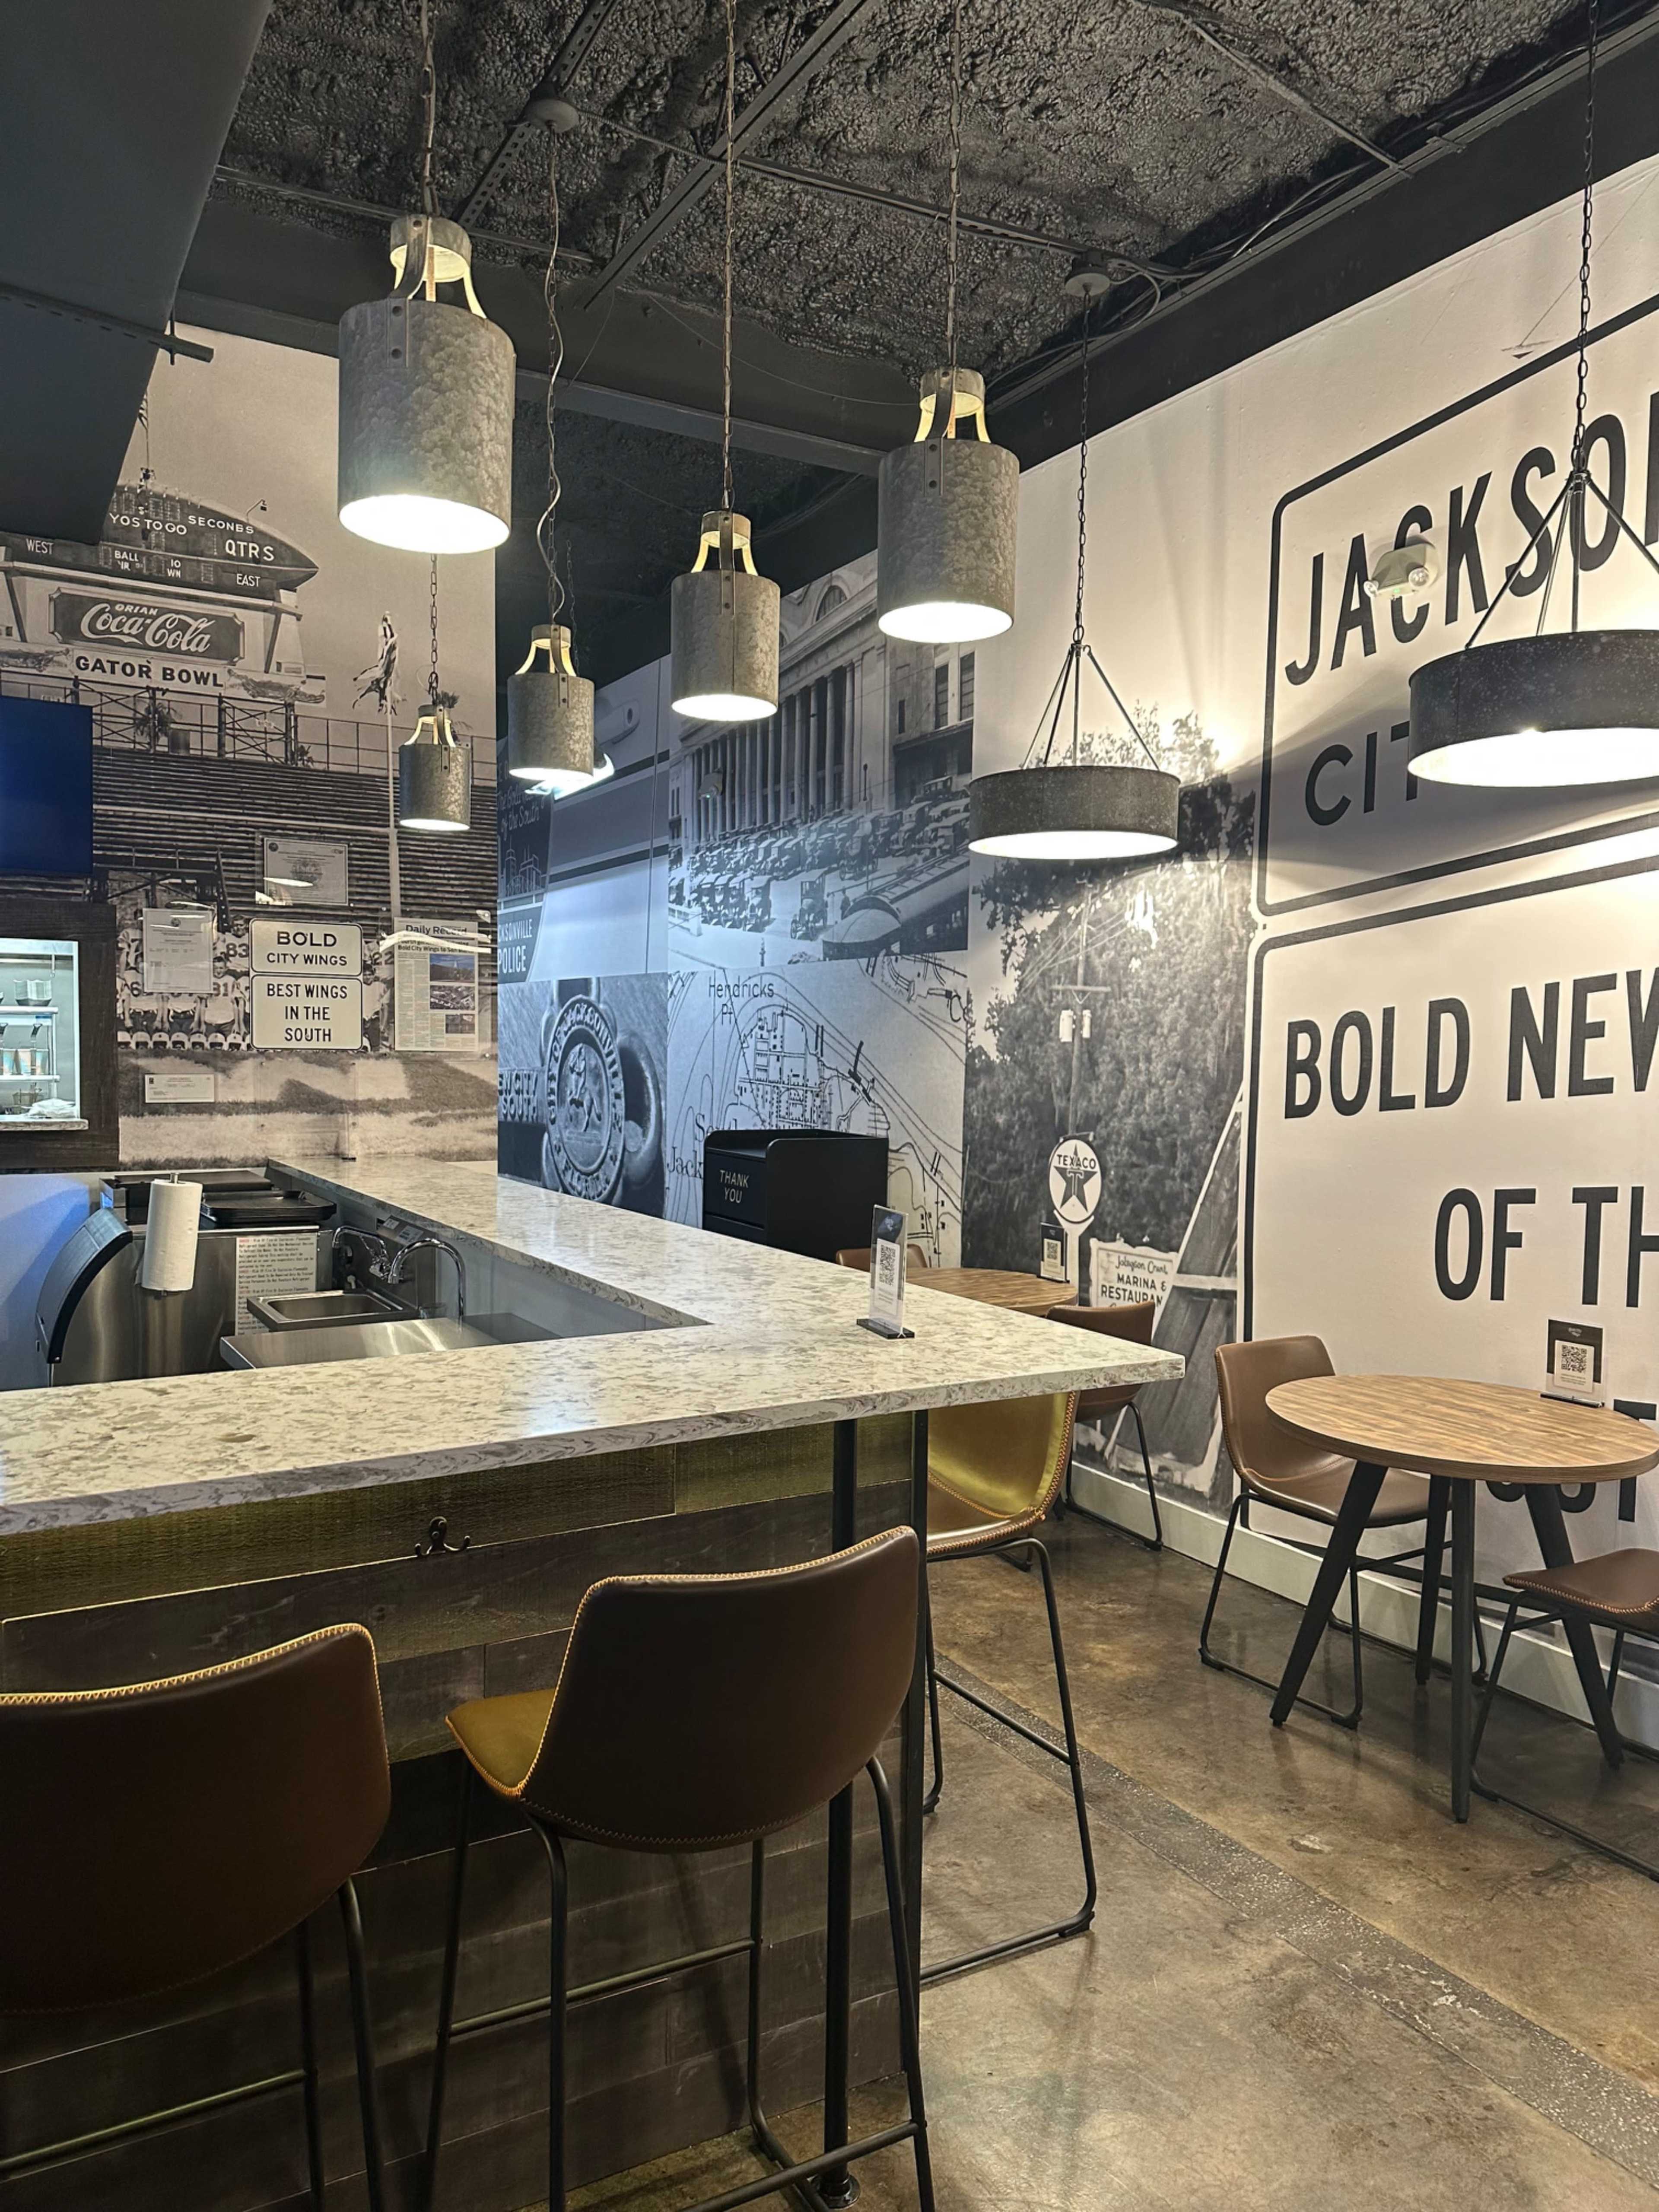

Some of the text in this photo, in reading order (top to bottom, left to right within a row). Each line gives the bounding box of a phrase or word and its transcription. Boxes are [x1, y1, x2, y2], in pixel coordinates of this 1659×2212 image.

[144, 519, 162, 530] TO
[165, 523, 187, 535] GO
[26, 538, 54, 555] WEST
[1285, 391, 1659, 686] JACKSO
[114, 550, 139, 562] BALL
[237, 573, 261, 587] EAST
[81, 603, 215, 653] Coca-Cola
[76, 655, 224, 687] GATOR BOWL
[406, 925, 431, 935] Daily
[277, 931, 337, 947] BOLD
[267, 952, 347, 966] CITY WINGS
[498, 945, 526, 974] POLICE
[267, 983, 347, 999] BEST WINGS
[708, 975, 774, 998] Hendricks
[285, 1006, 330, 1020] IN THE
[284, 1027, 331, 1042] SOUTH
[1284, 998, 1471, 1119] BOLD
[1057, 1154, 1096, 1170] TEXACO
[719, 1169, 750, 1188] THANK
[725, 1187, 742, 1203] YOU
[1434, 1188, 1536, 1301] OF
[1117, 1273, 1157, 1290] MARINA
